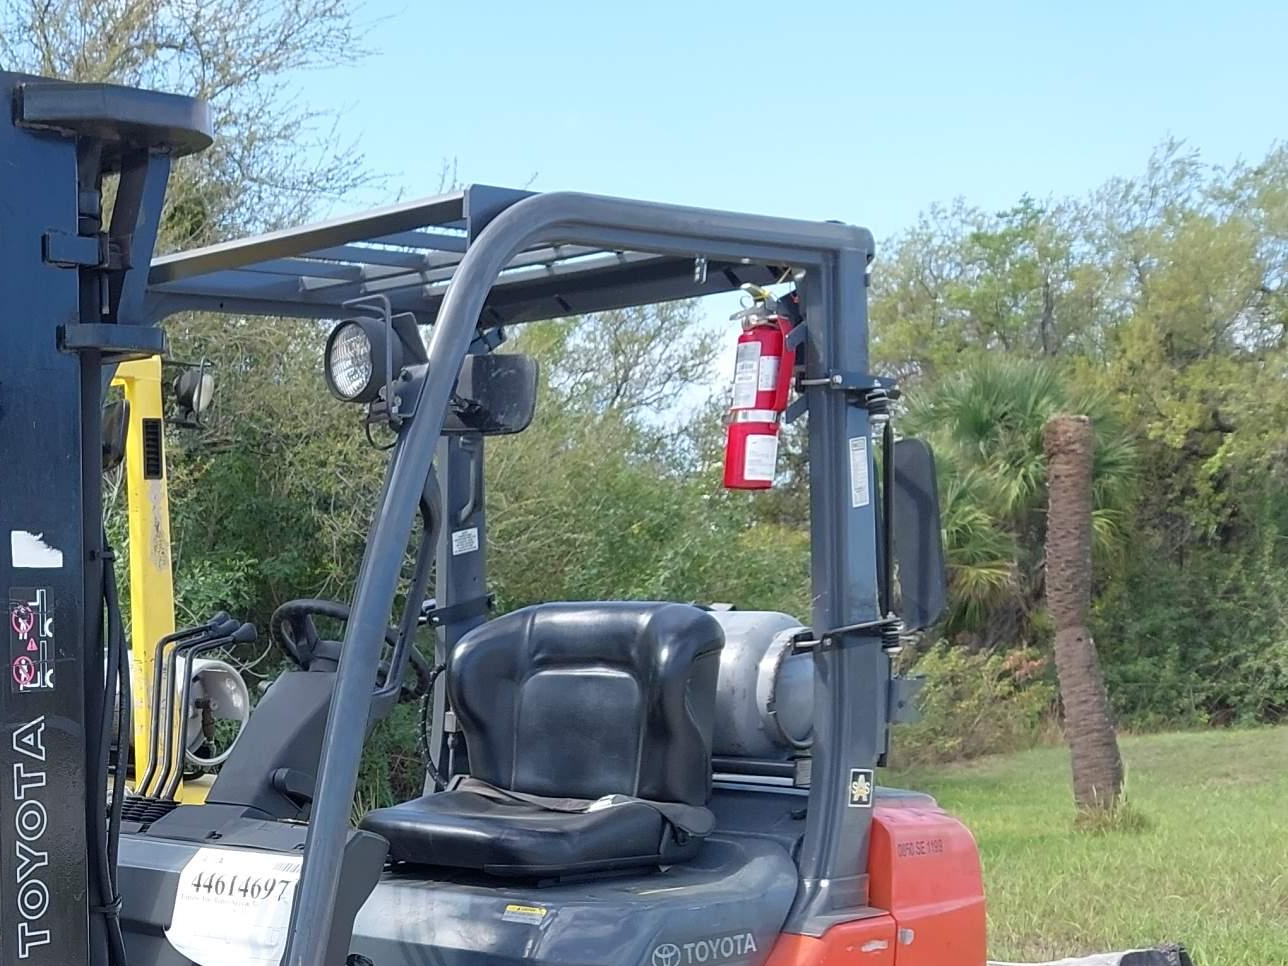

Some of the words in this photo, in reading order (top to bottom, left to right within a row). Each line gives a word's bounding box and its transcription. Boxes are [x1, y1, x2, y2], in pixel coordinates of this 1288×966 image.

[13, 714, 51, 959] TOYOTA
[191, 871, 292, 902] 44614697
[683, 932, 757, 964] TOYOTA
